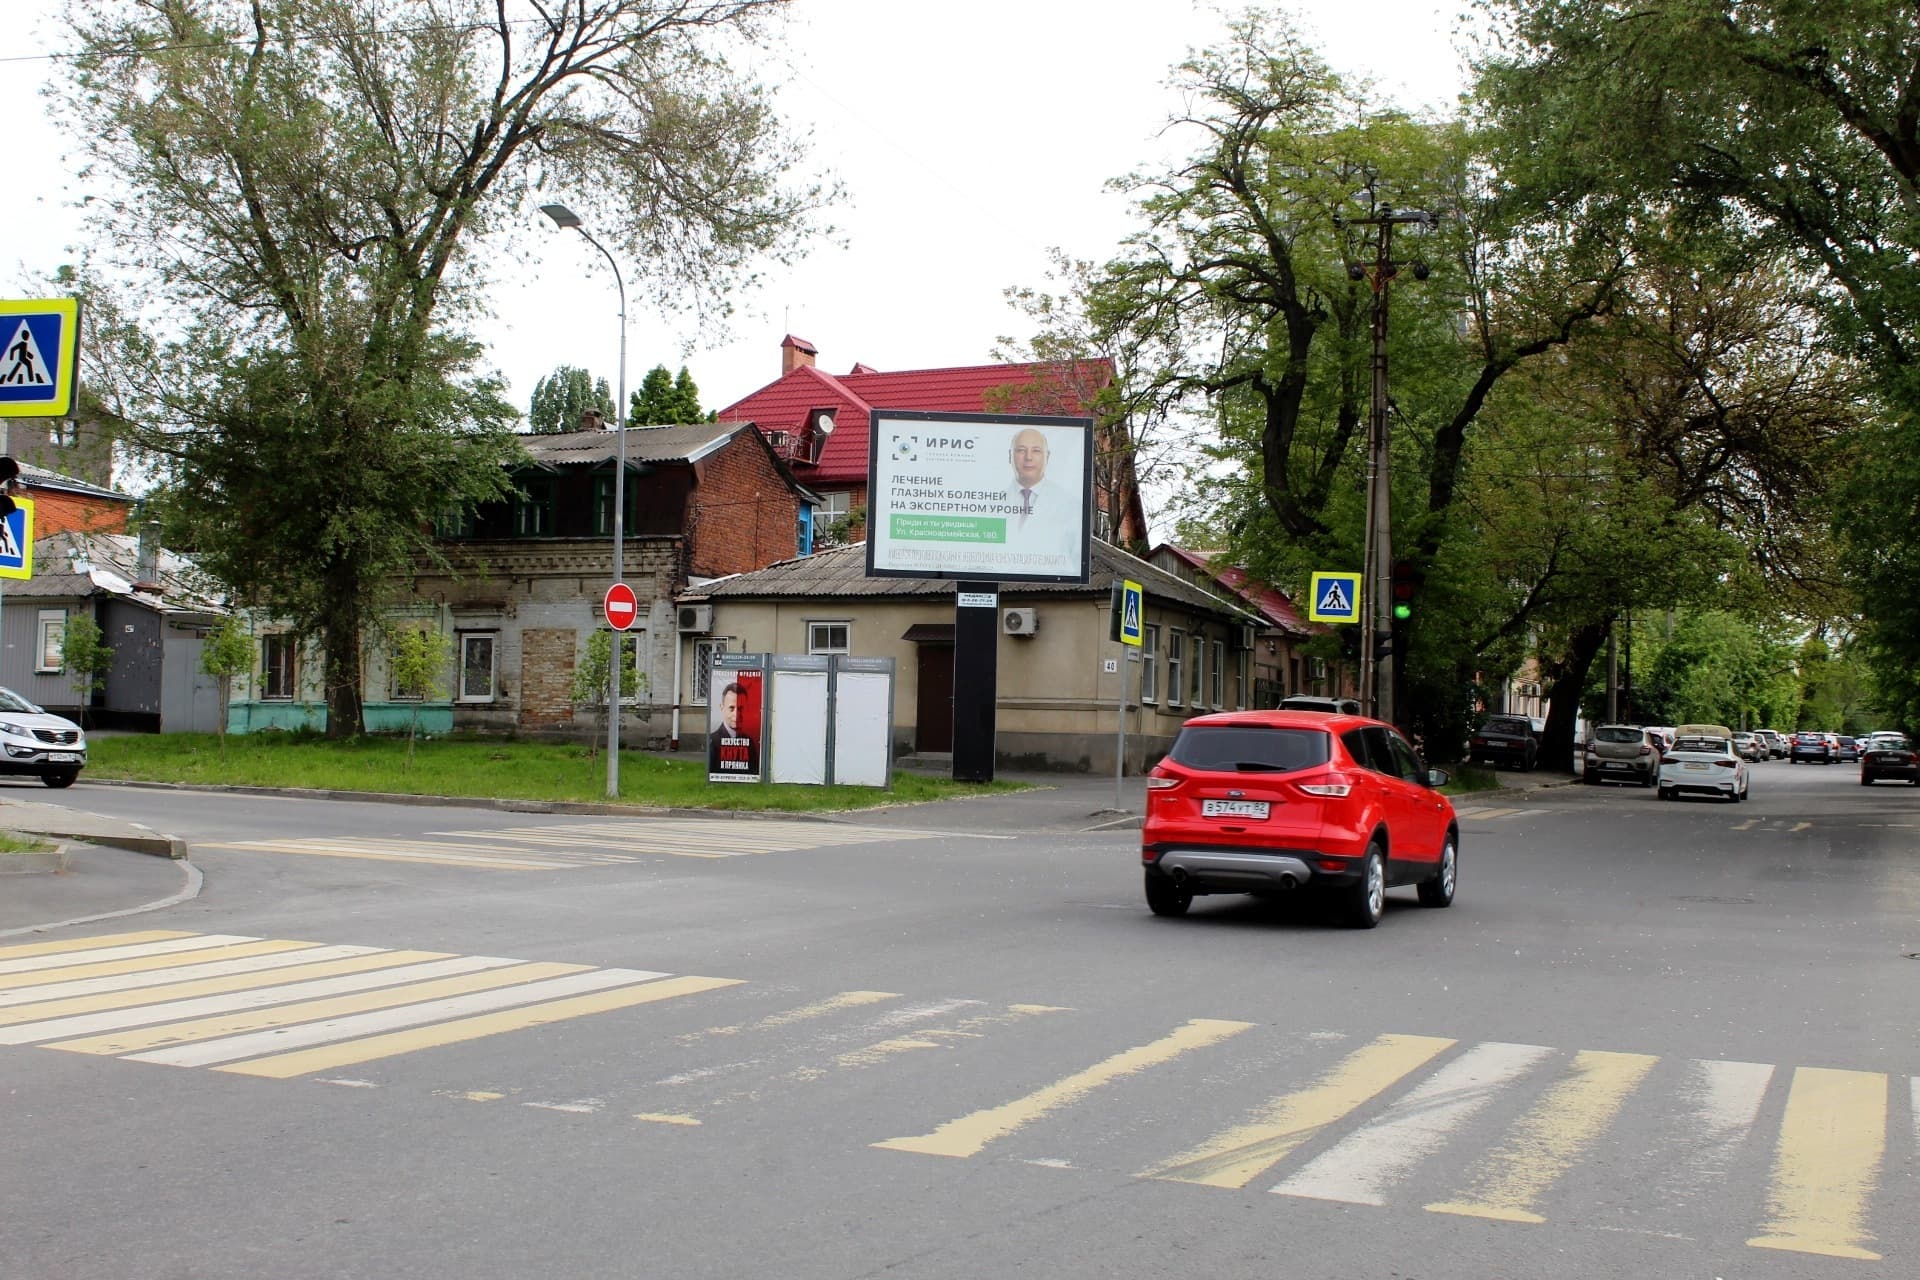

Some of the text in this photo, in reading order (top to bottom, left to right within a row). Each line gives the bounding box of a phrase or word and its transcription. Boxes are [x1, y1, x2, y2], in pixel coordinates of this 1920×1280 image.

[926, 437, 975, 450] ИРИС
[891, 474, 943, 486] ЛЕЧЕНИЕ
[891, 487, 1007, 501] ГЛАЗНЫХ БОЛЕЗНЕЙ
[890, 501, 1034, 515] НА ЭКСПЕРТНОМ УРОВНЕ
[896, 518, 922, 527] Приди
[721, 737, 750, 747] ИСКУССТВО
[720, 746, 749, 761] КНУТА
[724, 760, 749, 770] ПРЯНИКА
